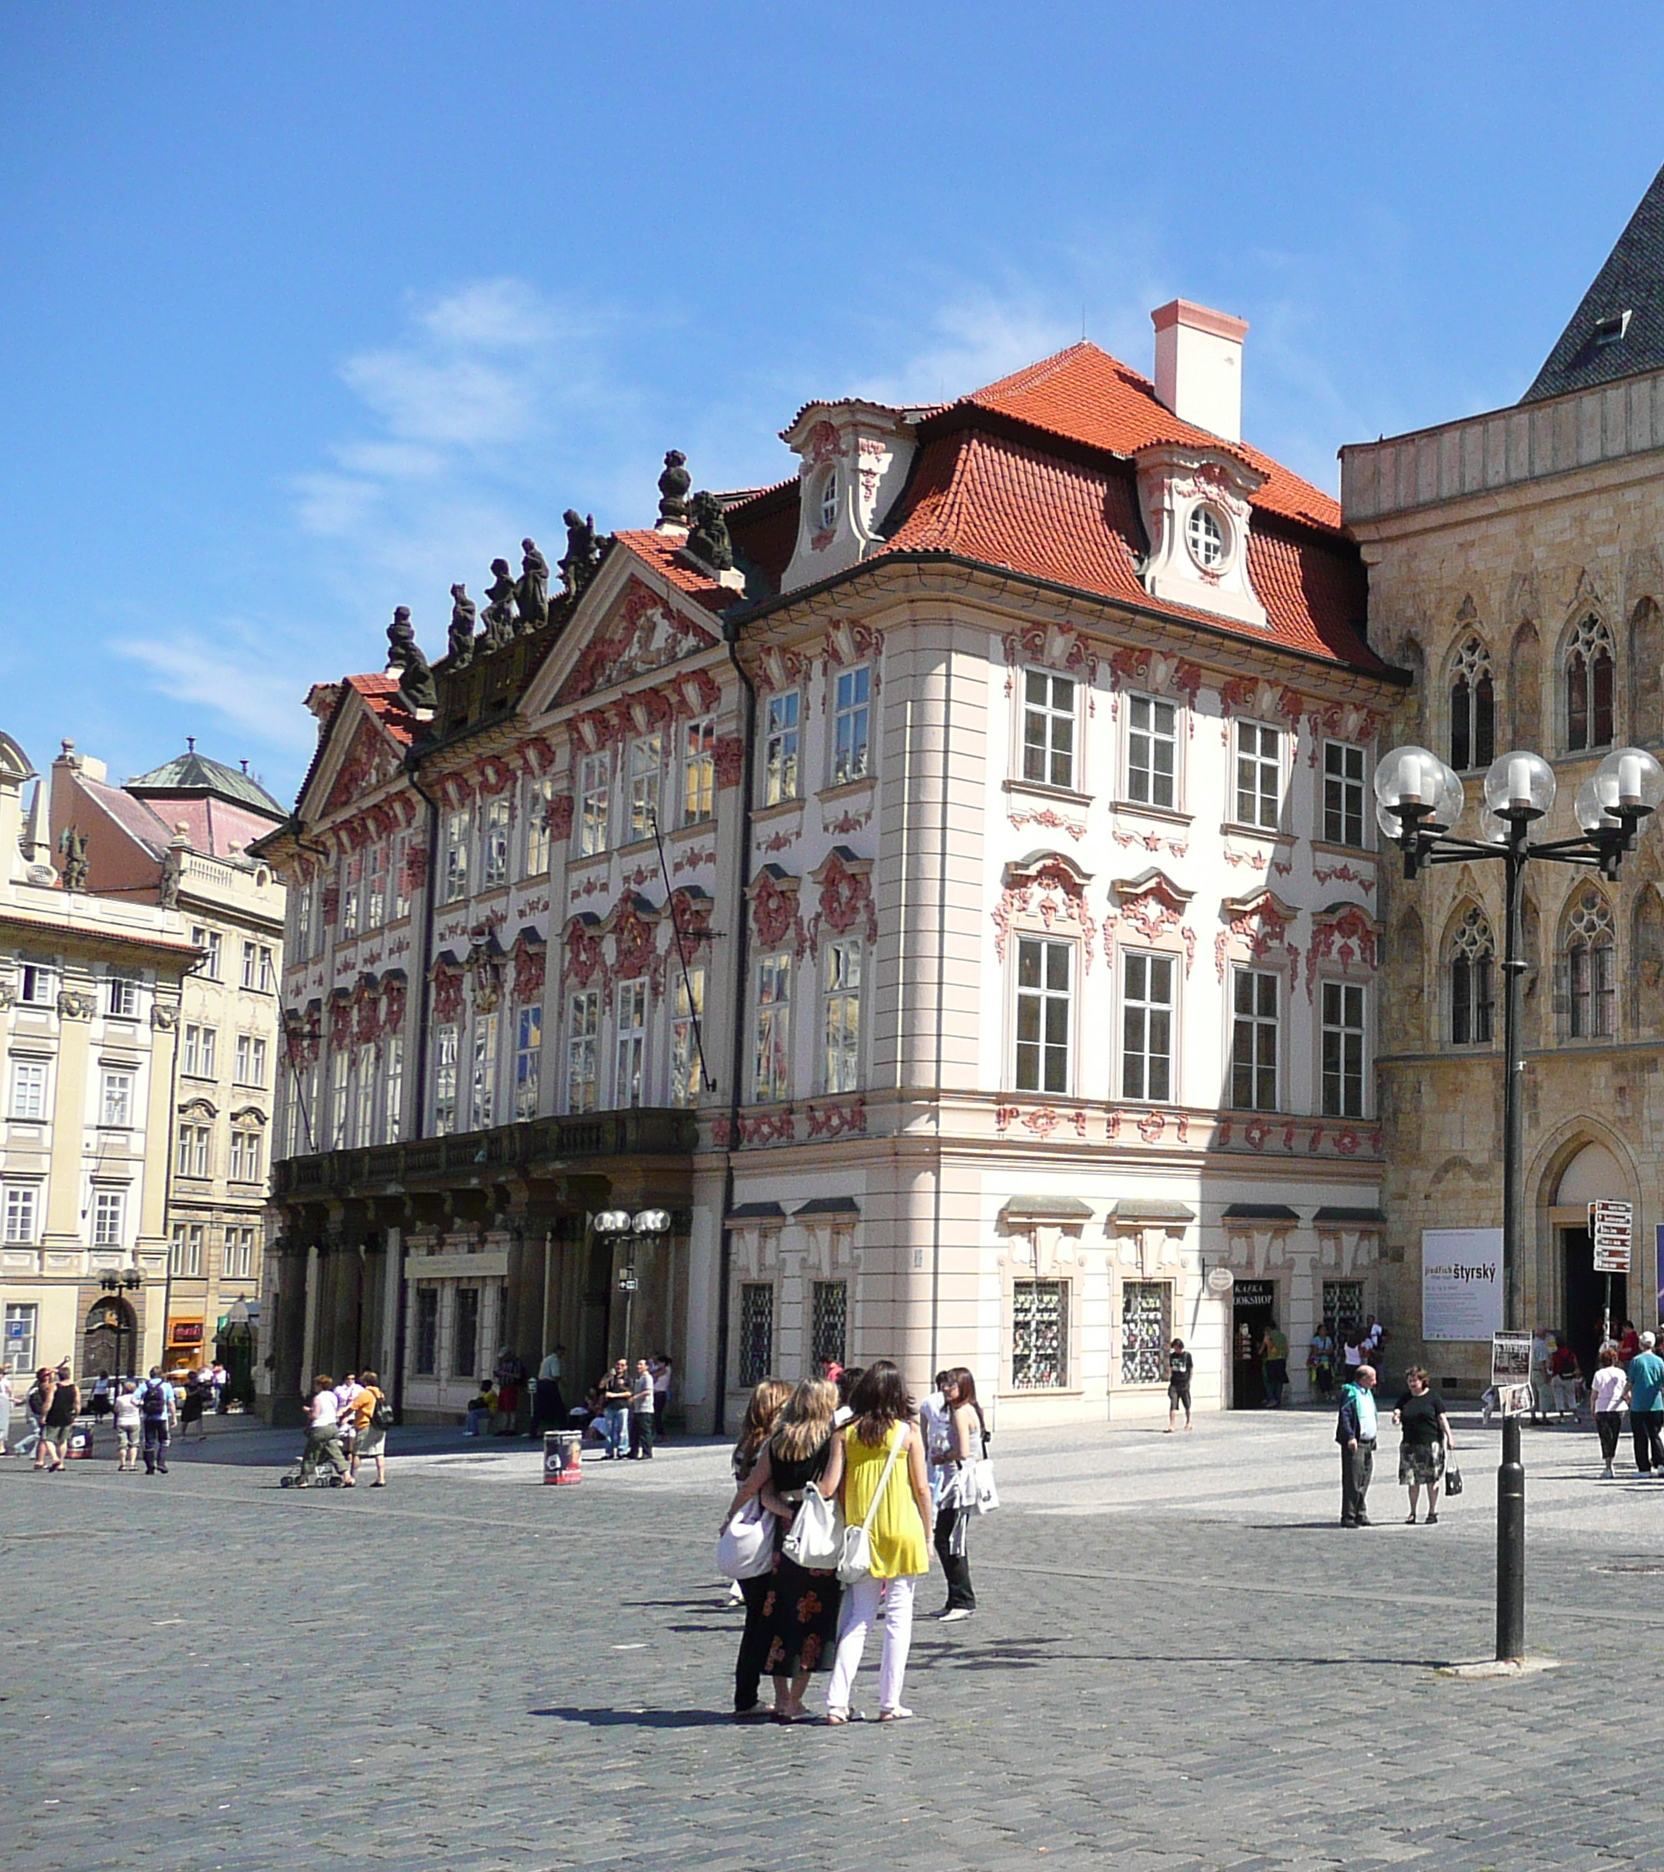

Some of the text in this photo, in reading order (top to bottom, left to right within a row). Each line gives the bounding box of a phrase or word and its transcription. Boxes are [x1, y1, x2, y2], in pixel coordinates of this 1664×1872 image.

[1453, 1262, 1496, 1283] štyrský
[1234, 1284, 1263, 1293] KAFKA
[1233, 1295, 1273, 1305] OOKSHOP
[12, 1323, 21, 1334] P
